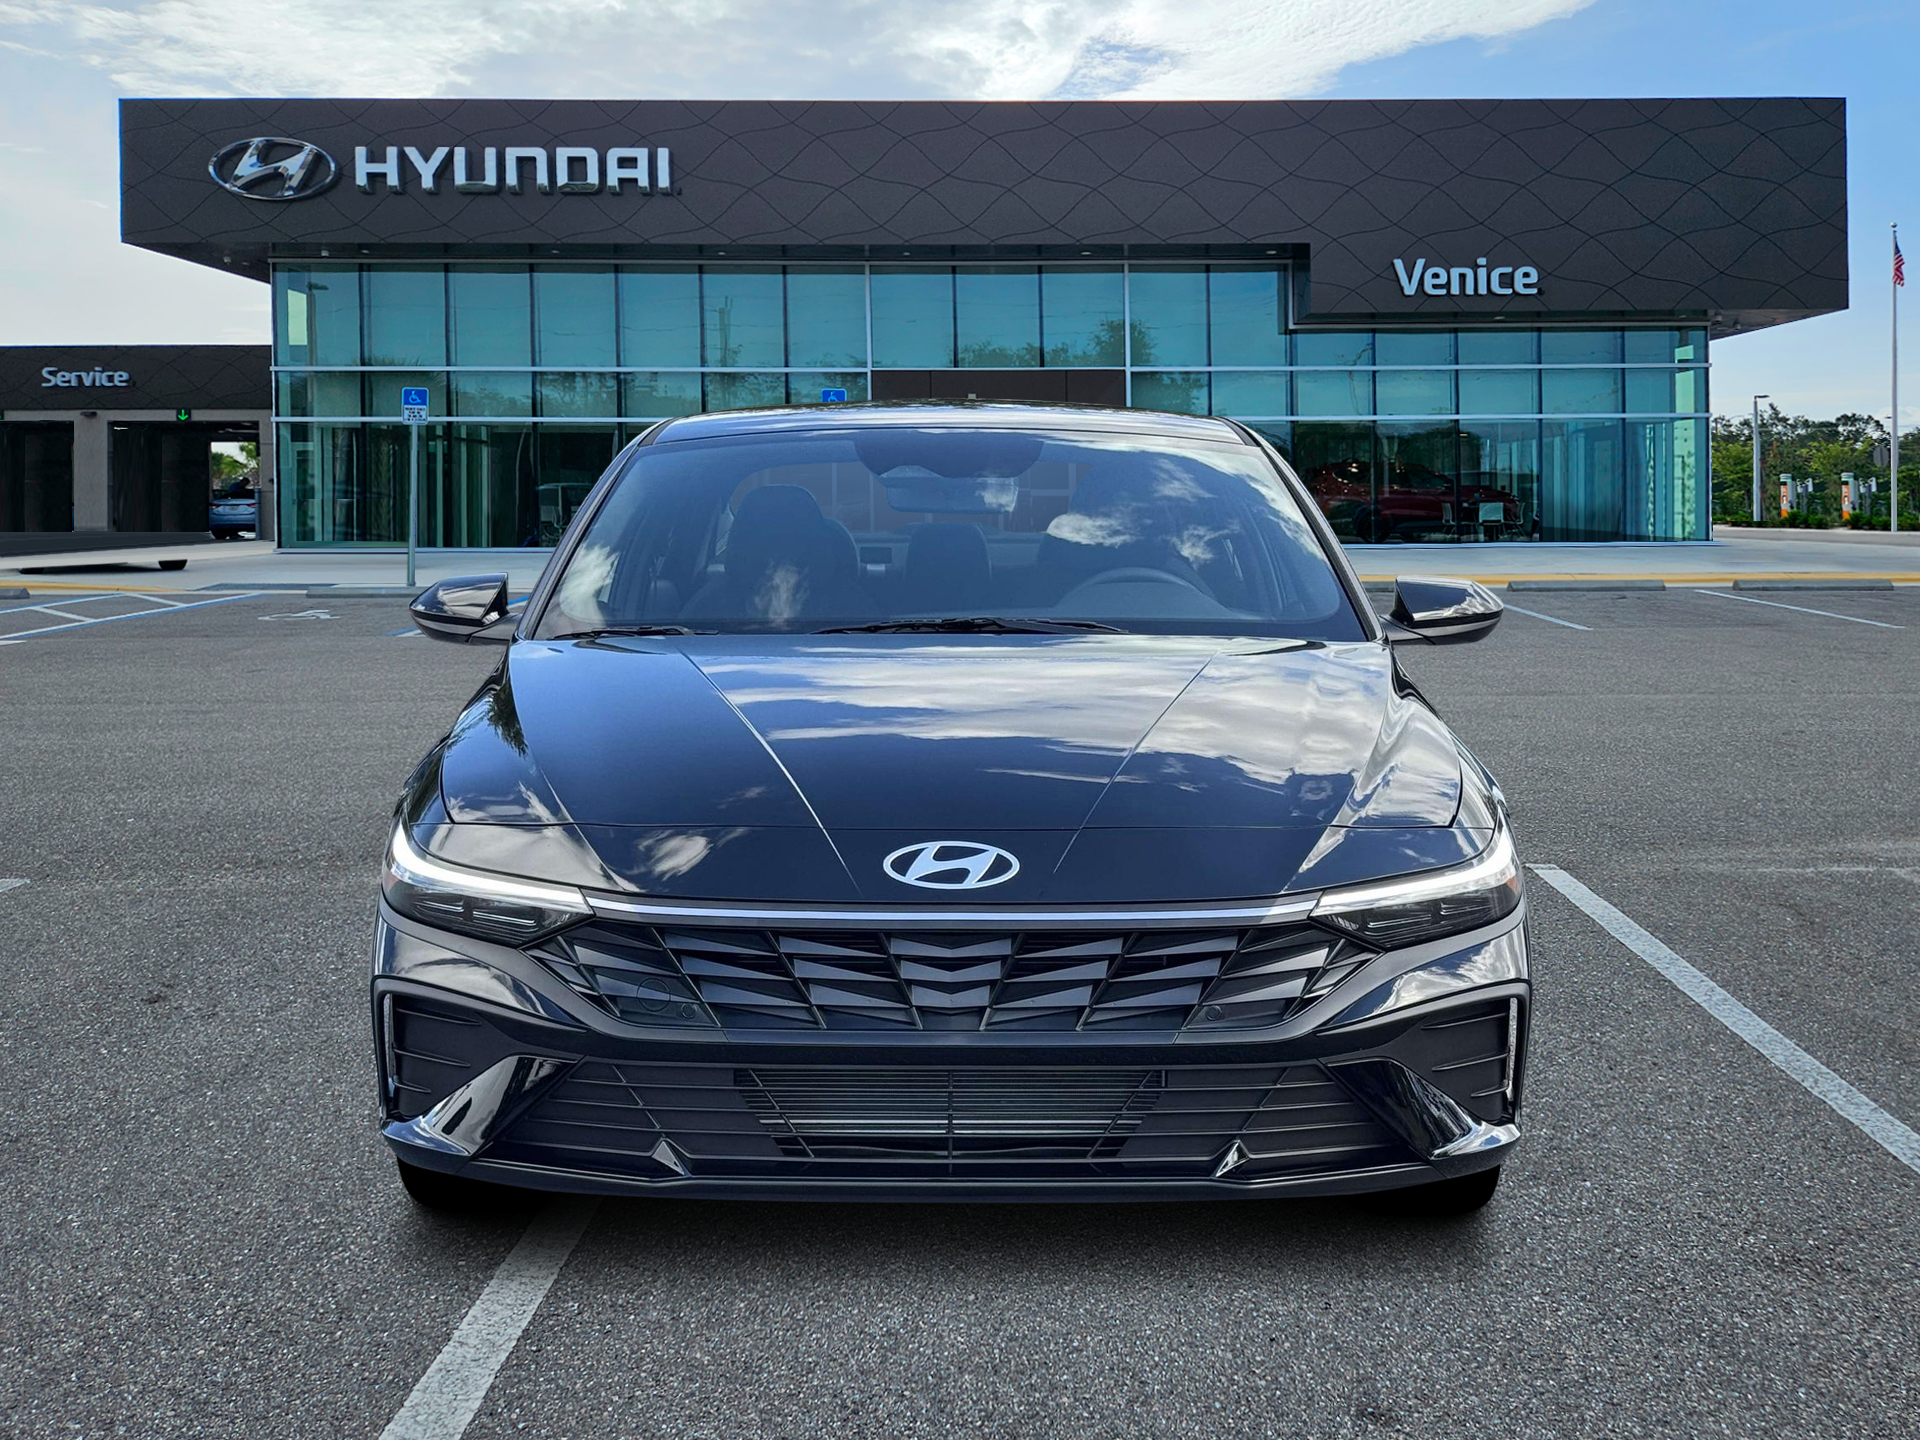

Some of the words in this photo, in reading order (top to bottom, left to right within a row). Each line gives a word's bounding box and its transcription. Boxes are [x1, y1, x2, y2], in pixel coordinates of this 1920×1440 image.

[354, 146, 670, 194] HYUNDAI
[1393, 257, 1539, 296] Venice
[41, 366, 130, 387] Service
